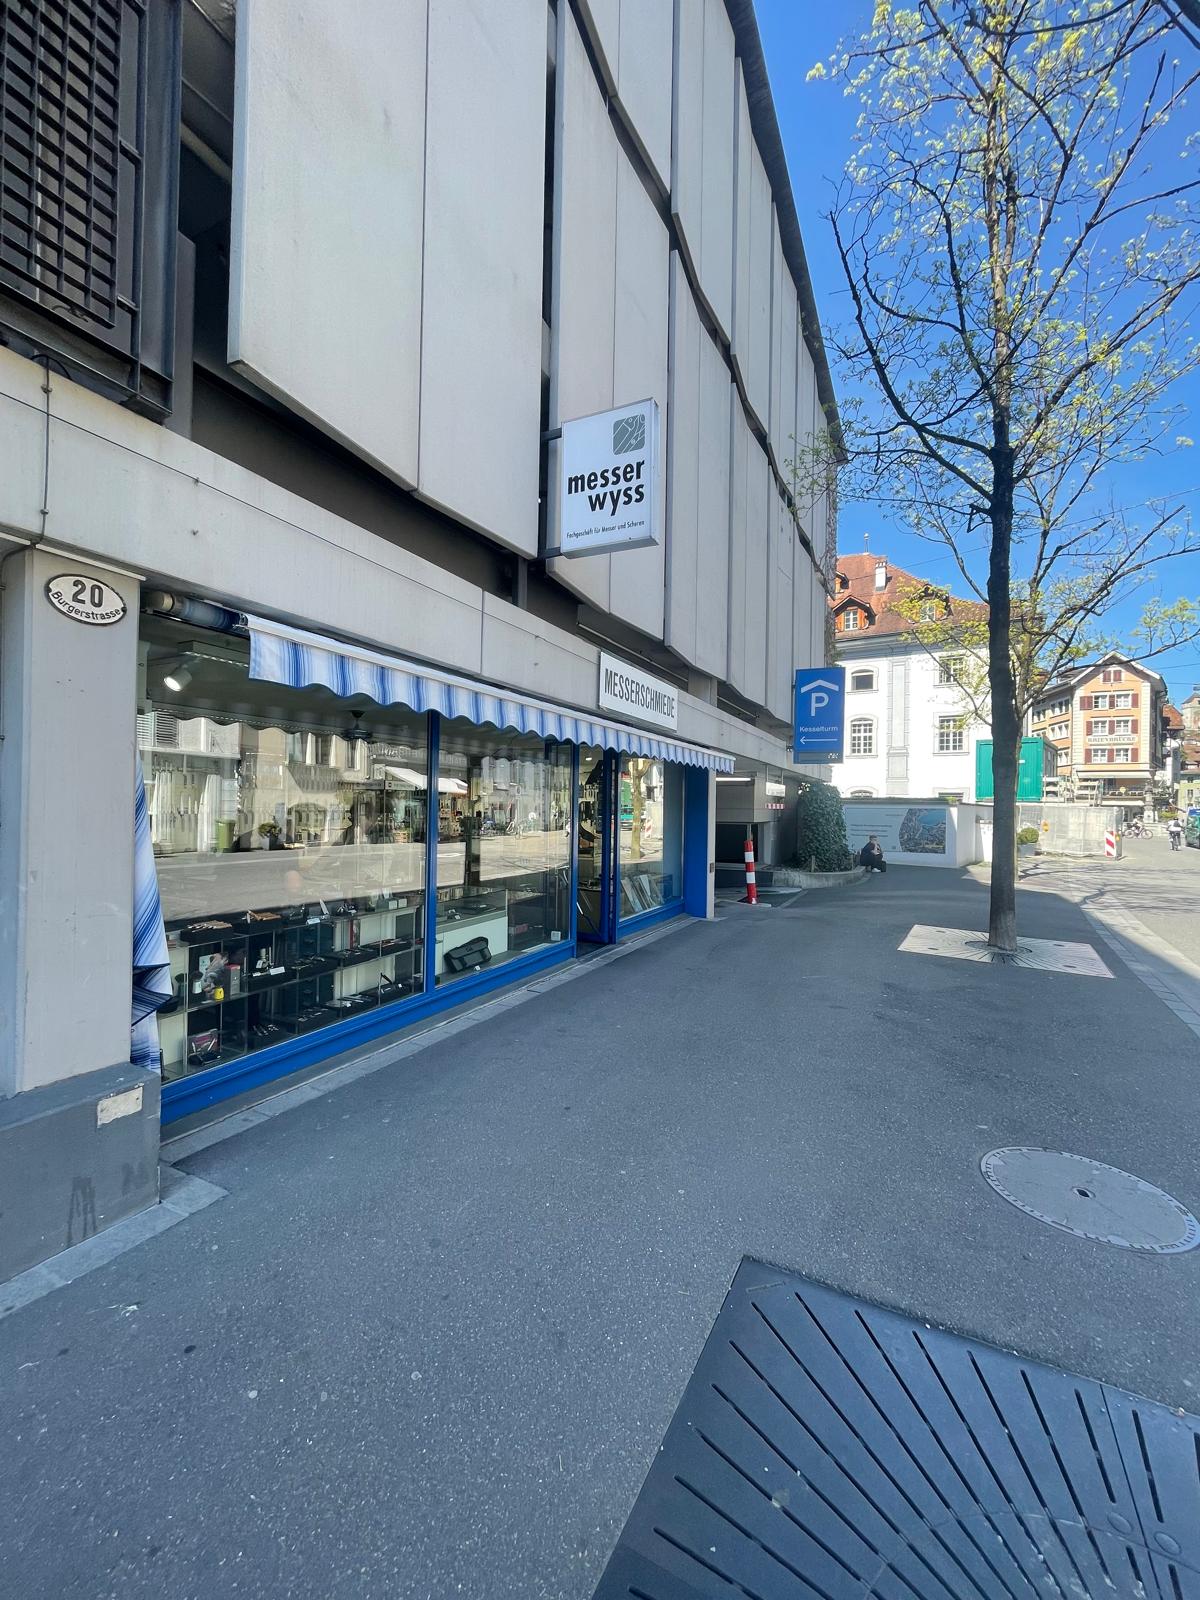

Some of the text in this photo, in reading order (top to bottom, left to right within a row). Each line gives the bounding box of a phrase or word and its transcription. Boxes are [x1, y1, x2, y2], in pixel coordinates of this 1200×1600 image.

[568, 460, 645, 495] messer
[588, 484, 645, 516] wyss
[566, 527, 594, 539] Fachgeschäft
[601, 524, 617, 532] Messer
[617, 521, 626, 530] und
[51, 590, 121, 621] Burgerstrasse
[72, 579, 104, 608] 20
[604, 668, 675, 718] MESSERSCHMIEDE
[810, 692, 829, 717] P
